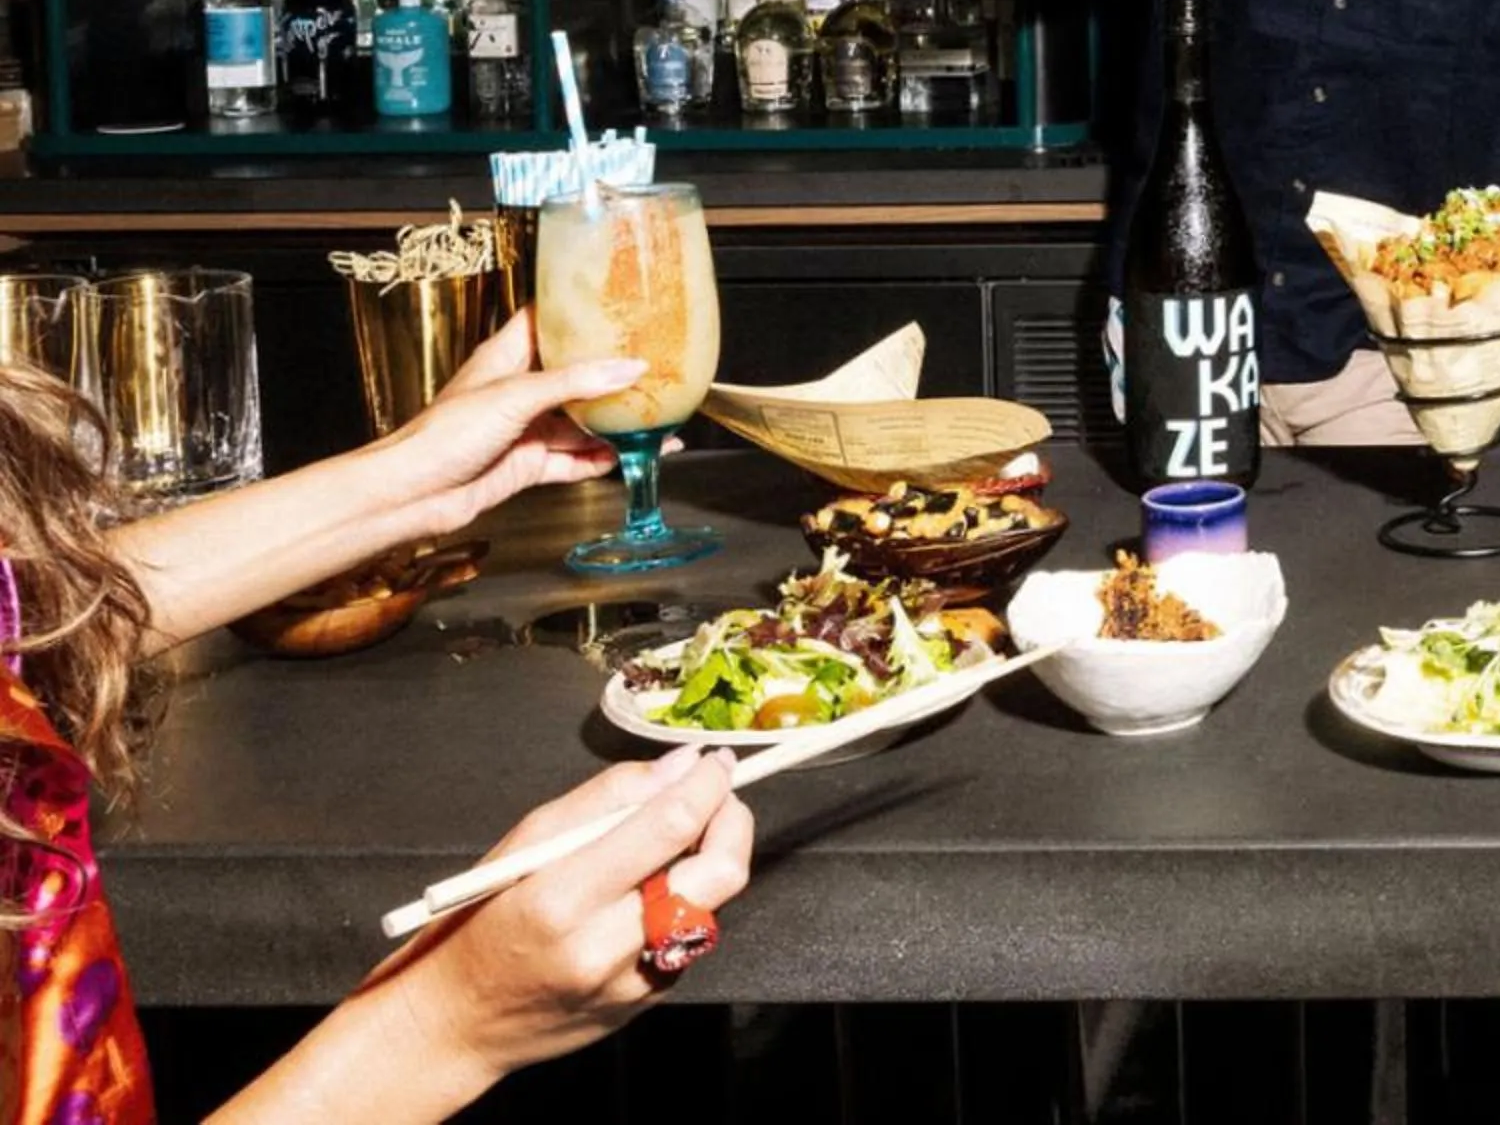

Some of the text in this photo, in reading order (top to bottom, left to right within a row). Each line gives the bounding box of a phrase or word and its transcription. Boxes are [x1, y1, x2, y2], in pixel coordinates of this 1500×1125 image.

[1163, 293, 1254, 357] WA
[1198, 350, 1259, 417] KA
[1165, 417, 1228, 478] ZE
